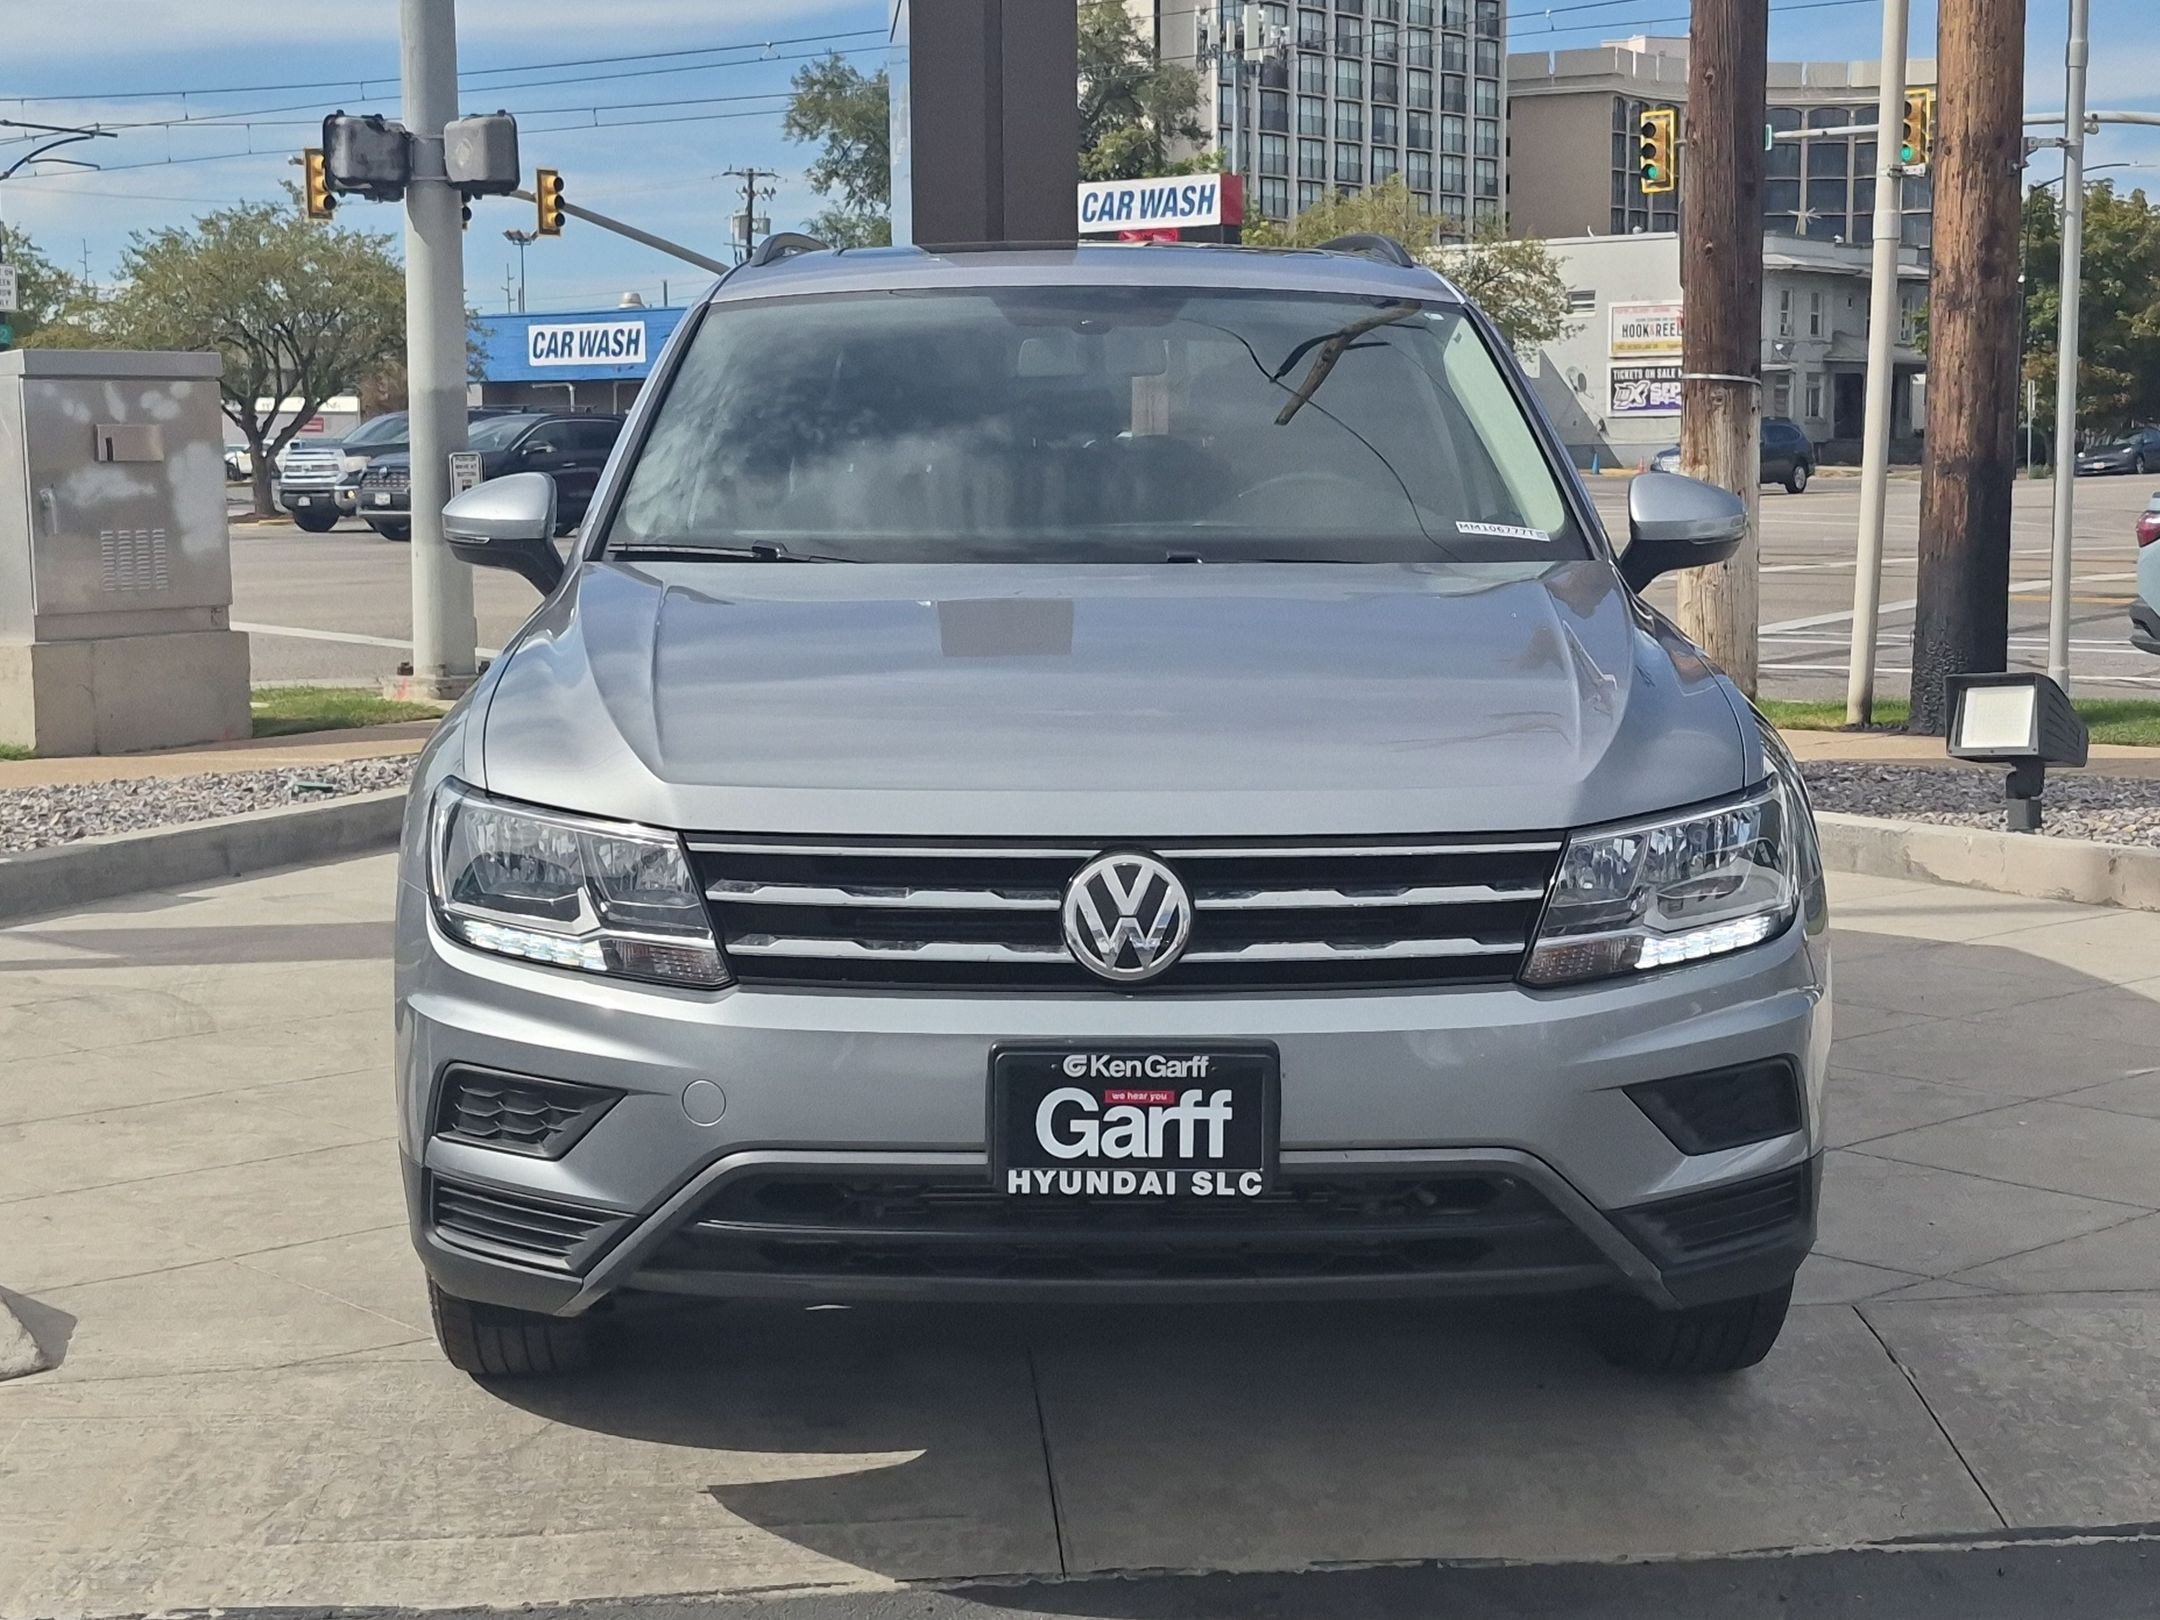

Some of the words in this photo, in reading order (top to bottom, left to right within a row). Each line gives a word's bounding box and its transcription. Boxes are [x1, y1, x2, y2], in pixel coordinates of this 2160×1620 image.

[1082, 190, 1135, 223] CAR
[1140, 184, 1216, 219] WASH
[532, 331, 575, 359] CAR
[579, 328, 641, 357] WASH
[1613, 368, 1643, 380] TICKETS
[1645, 368, 1654, 379] ON
[1657, 368, 1674, 379] SALE
[1127, 1092, 1147, 1100] hear
[1150, 1093, 1168, 1102] you
[1035, 1086, 1233, 1159] Garff
[1007, 1169, 1177, 1195] HYUNDAI
[1191, 1170, 1264, 1197] SLC
